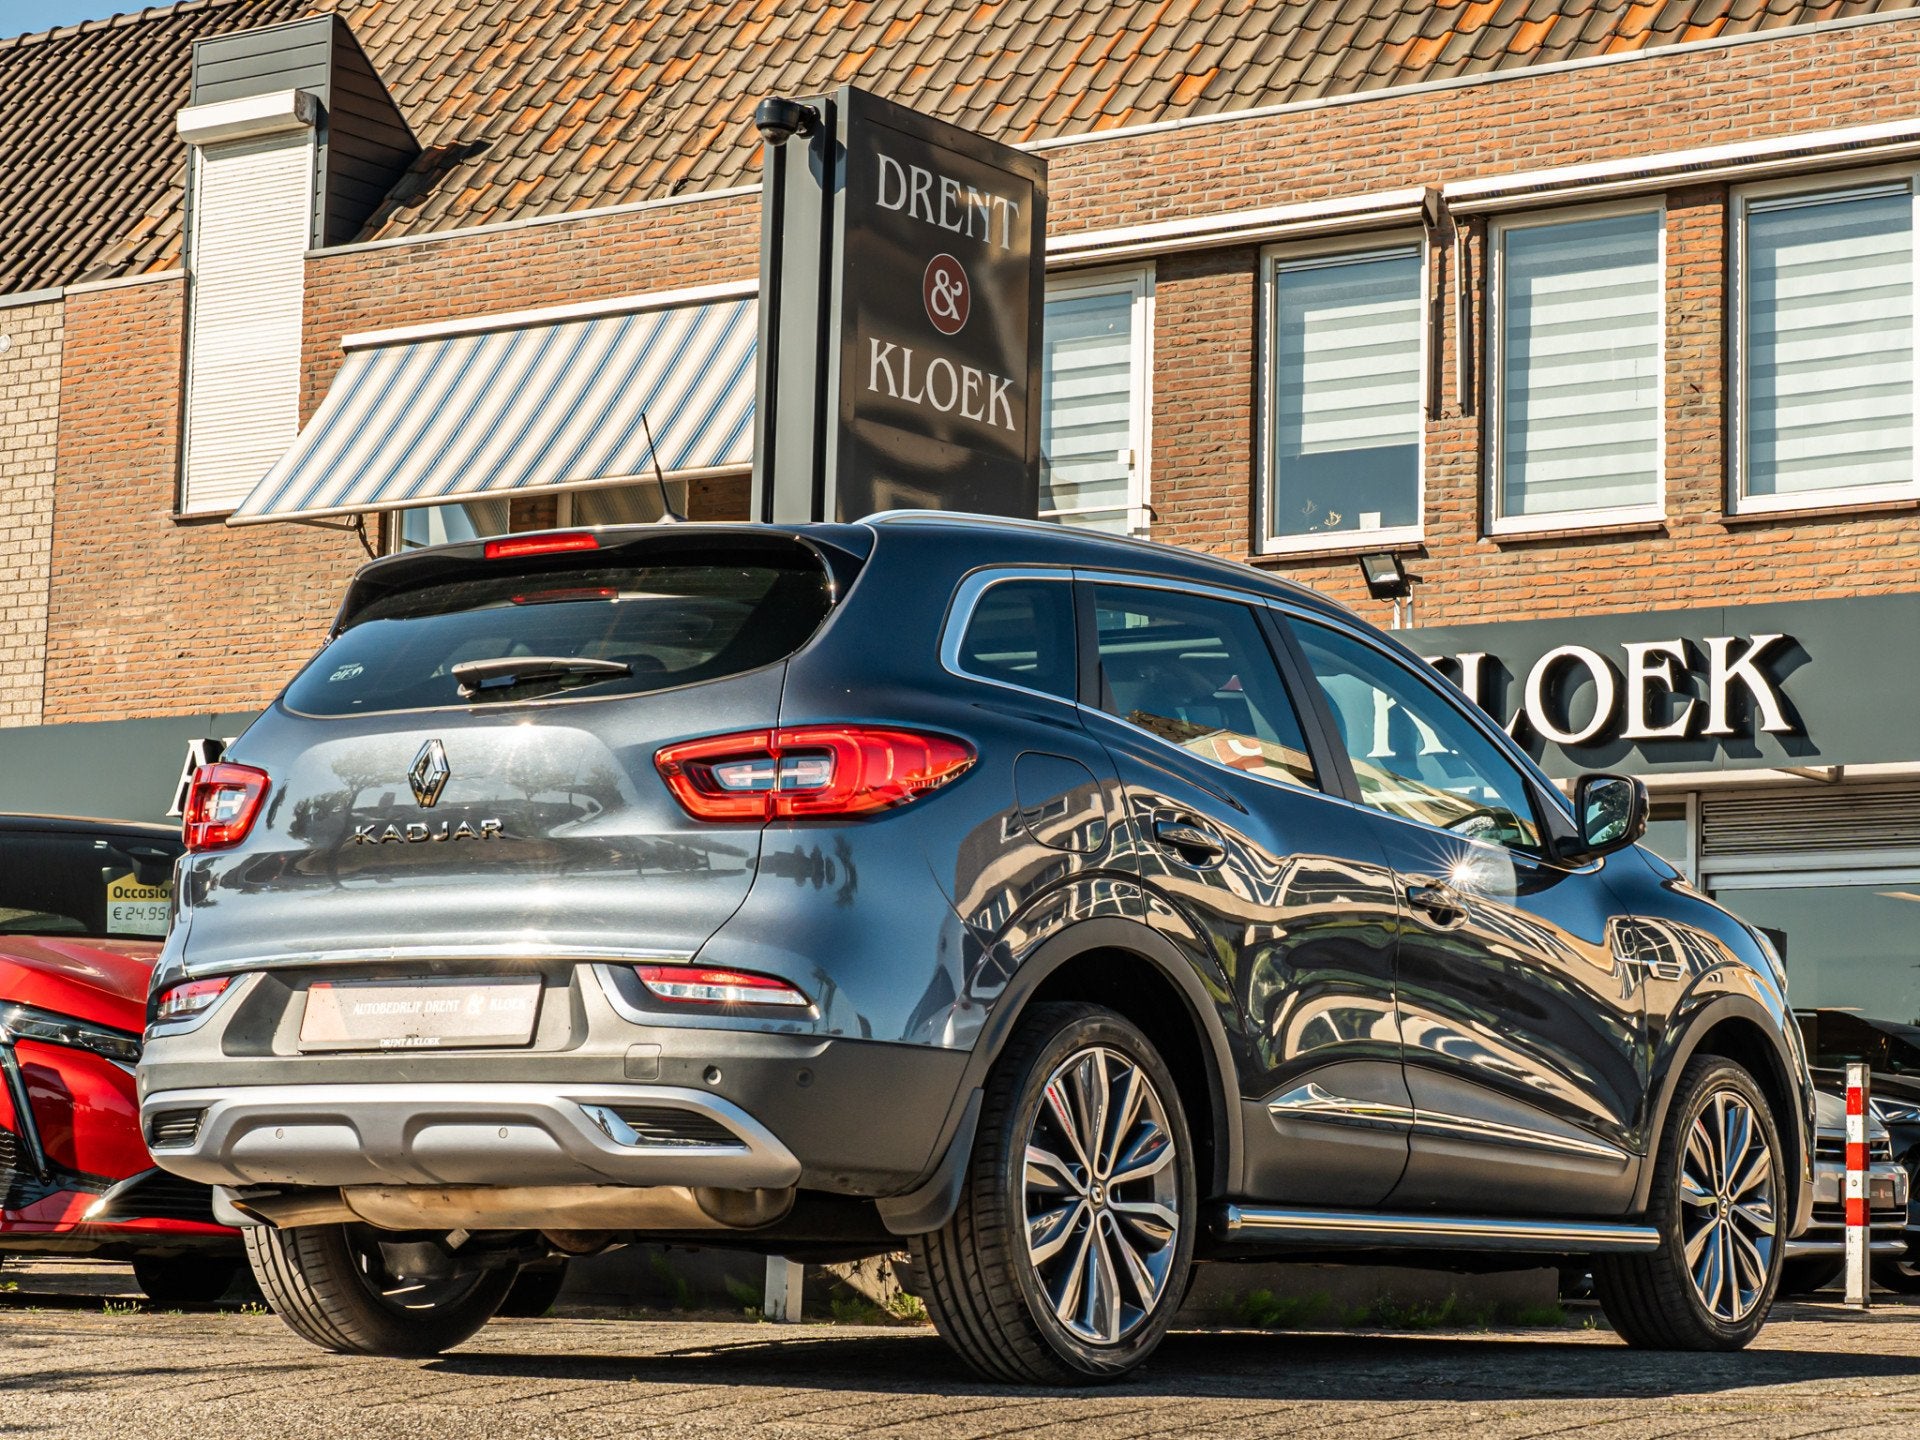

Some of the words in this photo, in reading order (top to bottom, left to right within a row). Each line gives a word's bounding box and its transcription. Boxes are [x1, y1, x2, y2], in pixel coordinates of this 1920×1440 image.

[875, 152, 1020, 251] DRENT
[930, 268, 963, 321] &
[867, 336, 1017, 431] KLOEK
[354, 818, 505, 845] KADJAR
[352, 1001, 423, 1015] AUTOBEDRIJF
[424, 999, 461, 1013] DRENT
[488, 997, 528, 1011] KLOEK
